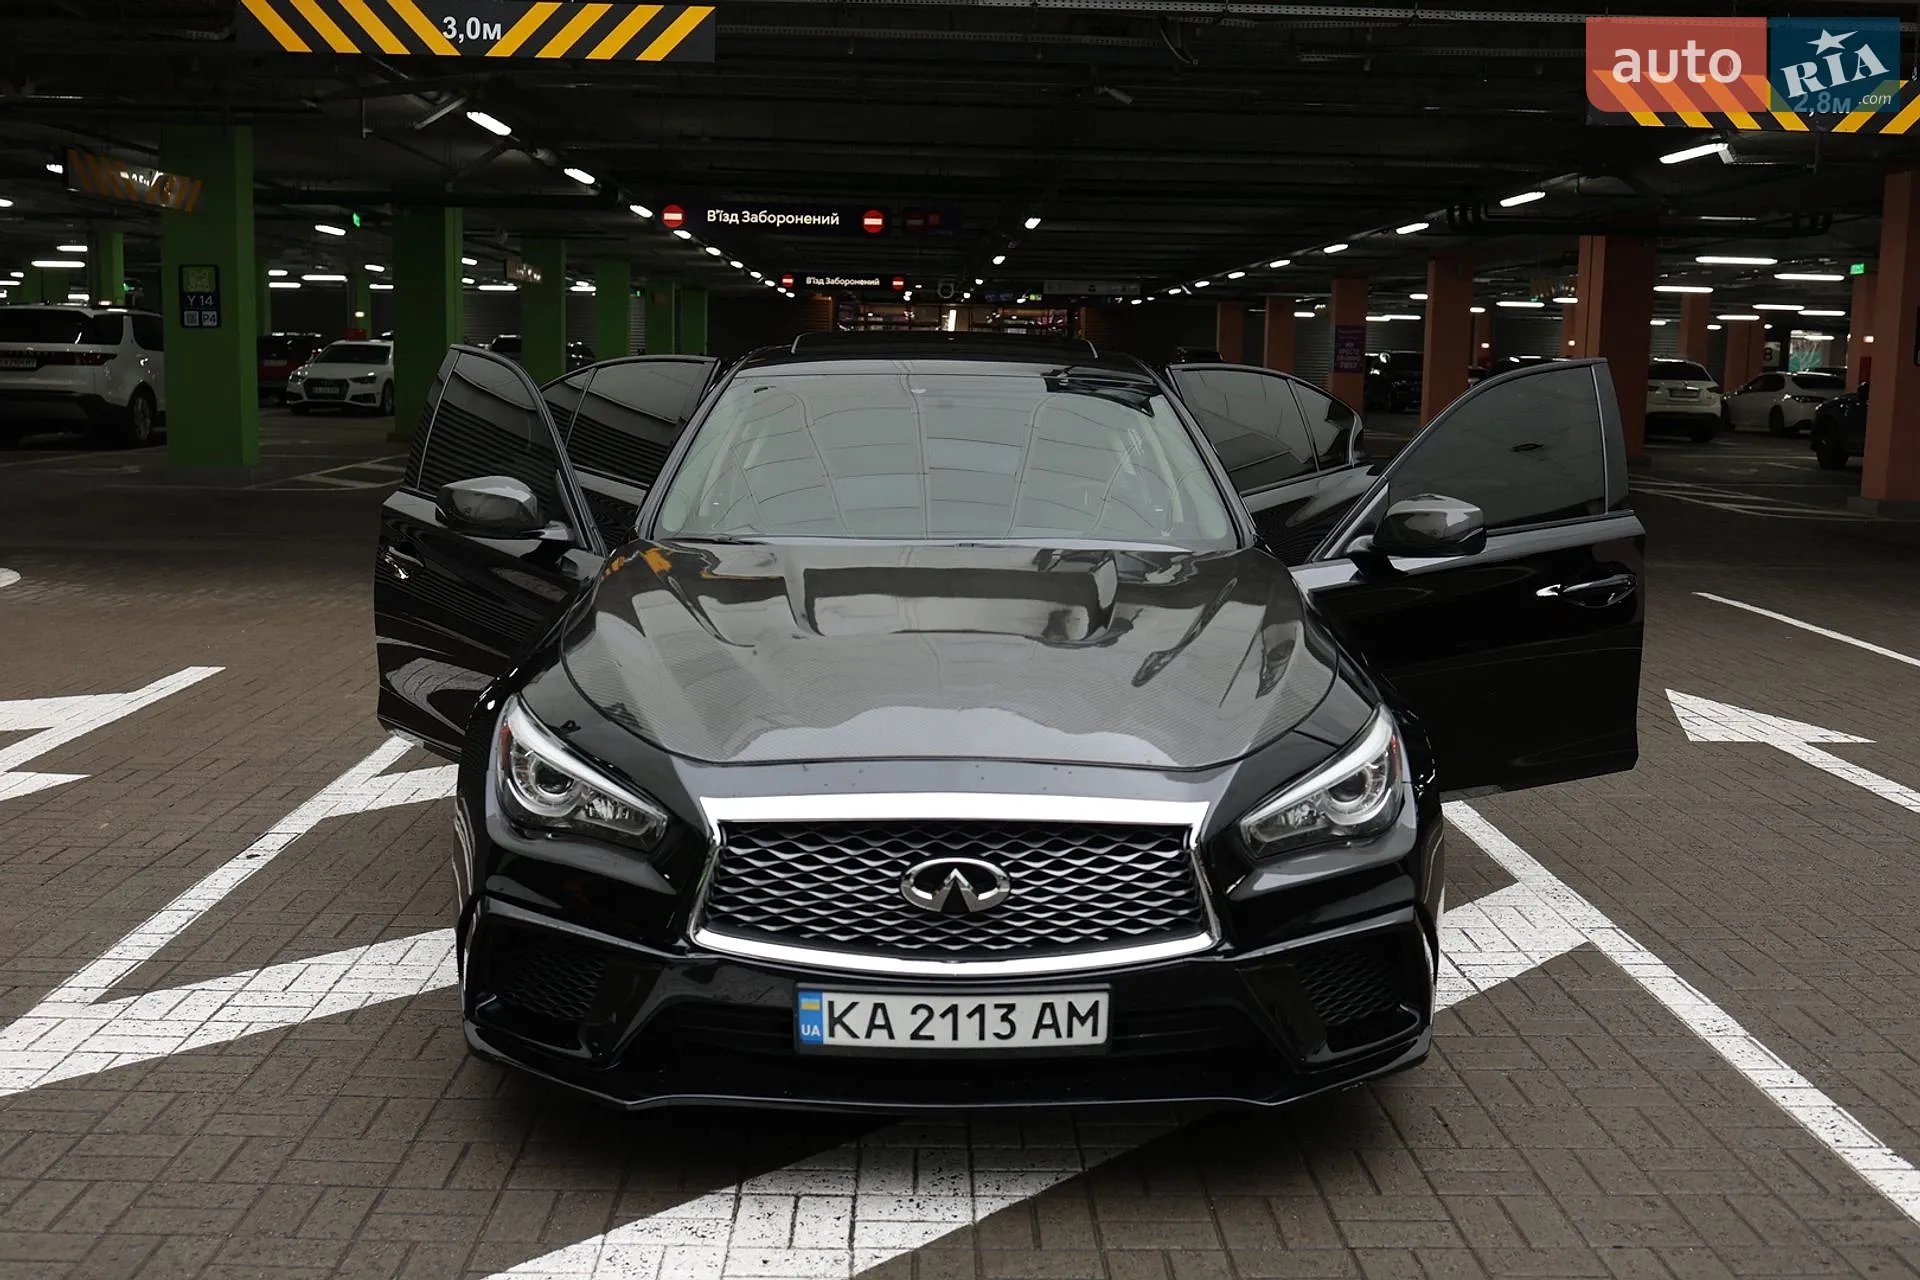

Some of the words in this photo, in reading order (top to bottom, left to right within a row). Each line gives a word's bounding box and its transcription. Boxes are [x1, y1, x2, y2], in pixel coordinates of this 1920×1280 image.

[443, 16, 501, 43] 3,0м
[742, 210, 839, 226] Заборонений
[826, 277, 880, 287] Заборонений
[200, 295, 214, 307] 14
[828, 1000, 895, 1040] KA
[910, 1002, 1017, 1041] 2113
[1032, 1000, 1100, 1040] AM
[801, 1024, 821, 1037] UA
